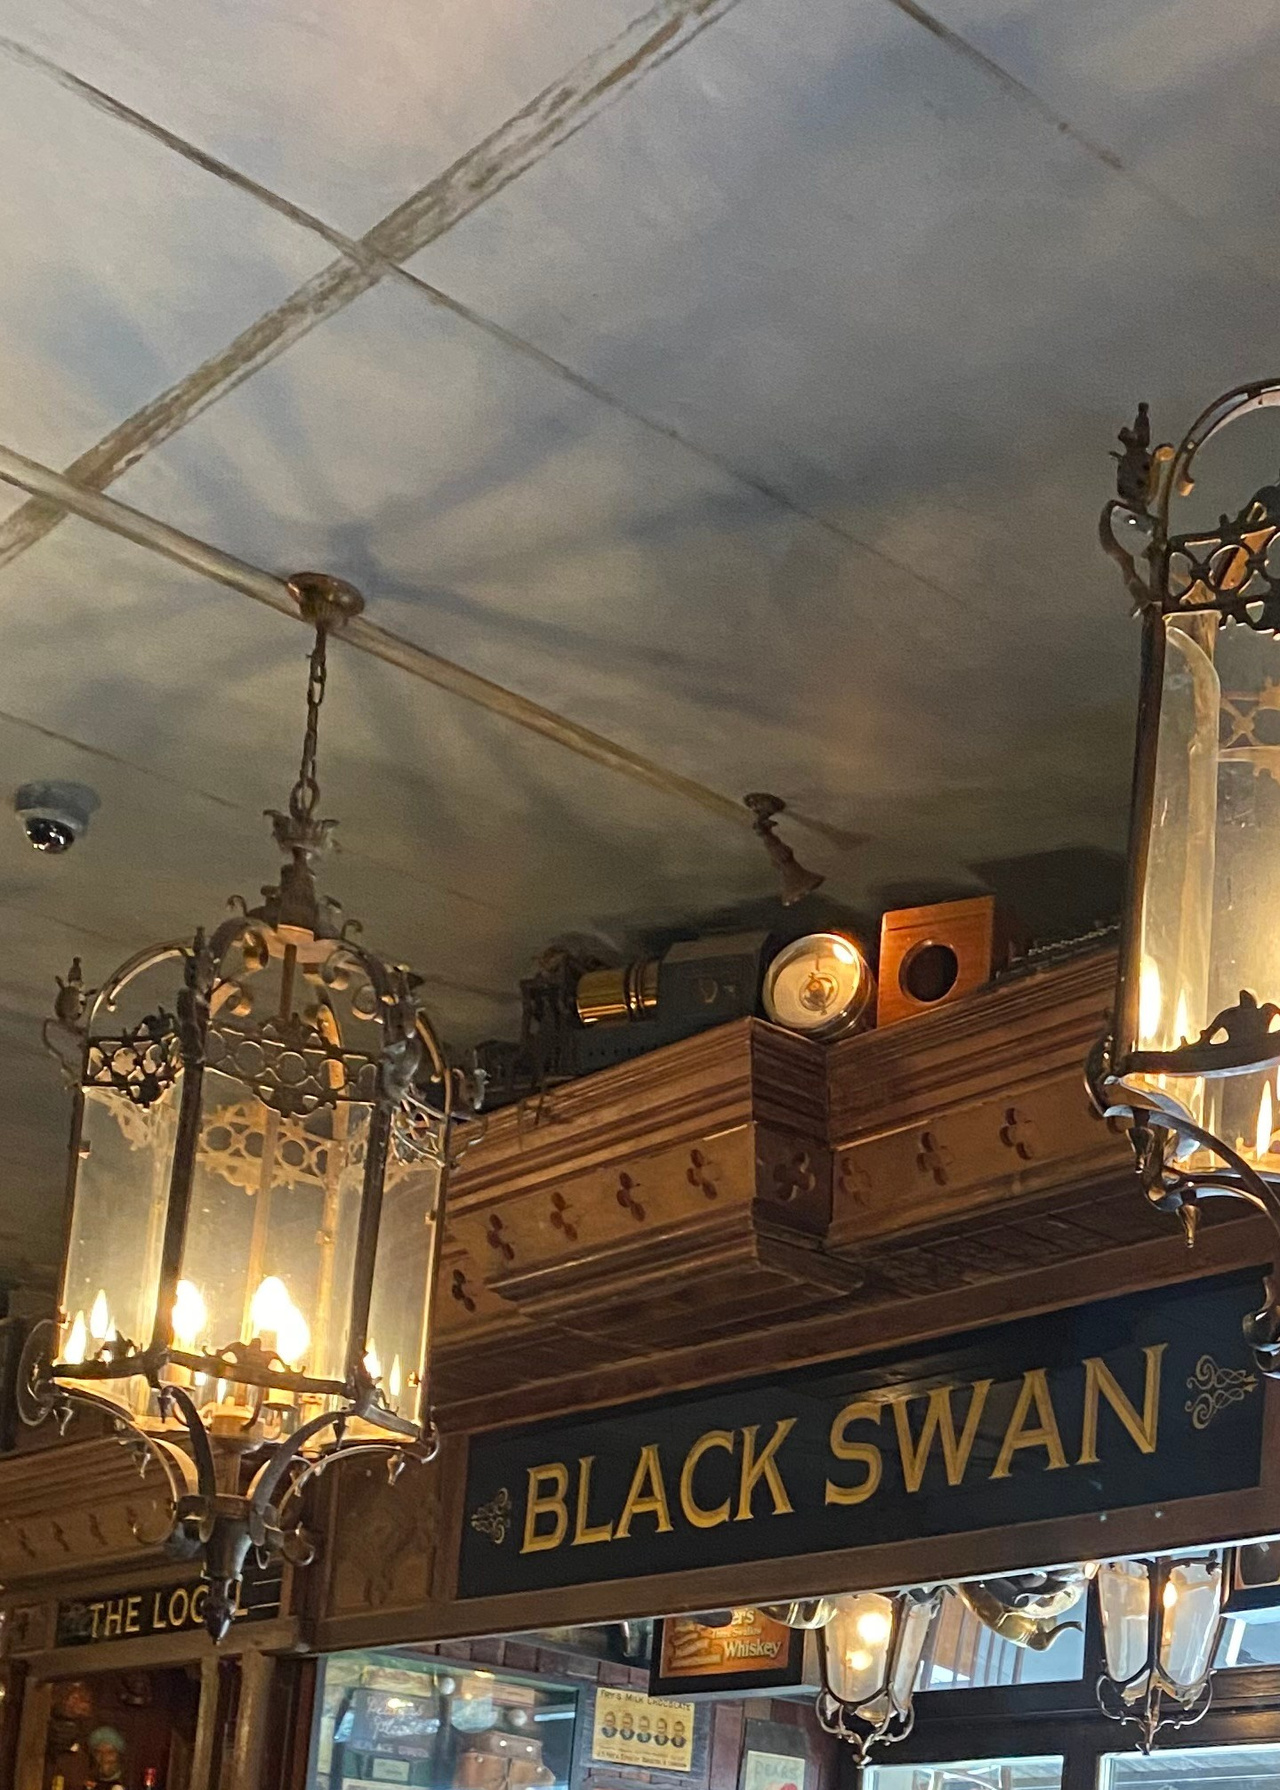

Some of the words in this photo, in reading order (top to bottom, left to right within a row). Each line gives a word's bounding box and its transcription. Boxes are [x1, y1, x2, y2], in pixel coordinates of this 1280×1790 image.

[519, 1417, 798, 1555] BLACK
[824, 1342, 1172, 1506] SWAN
[90, 1596, 142, 1639] THE
[153, 1580, 248, 1629] LOCL
[723, 1640, 782, 1659] Whiskey
